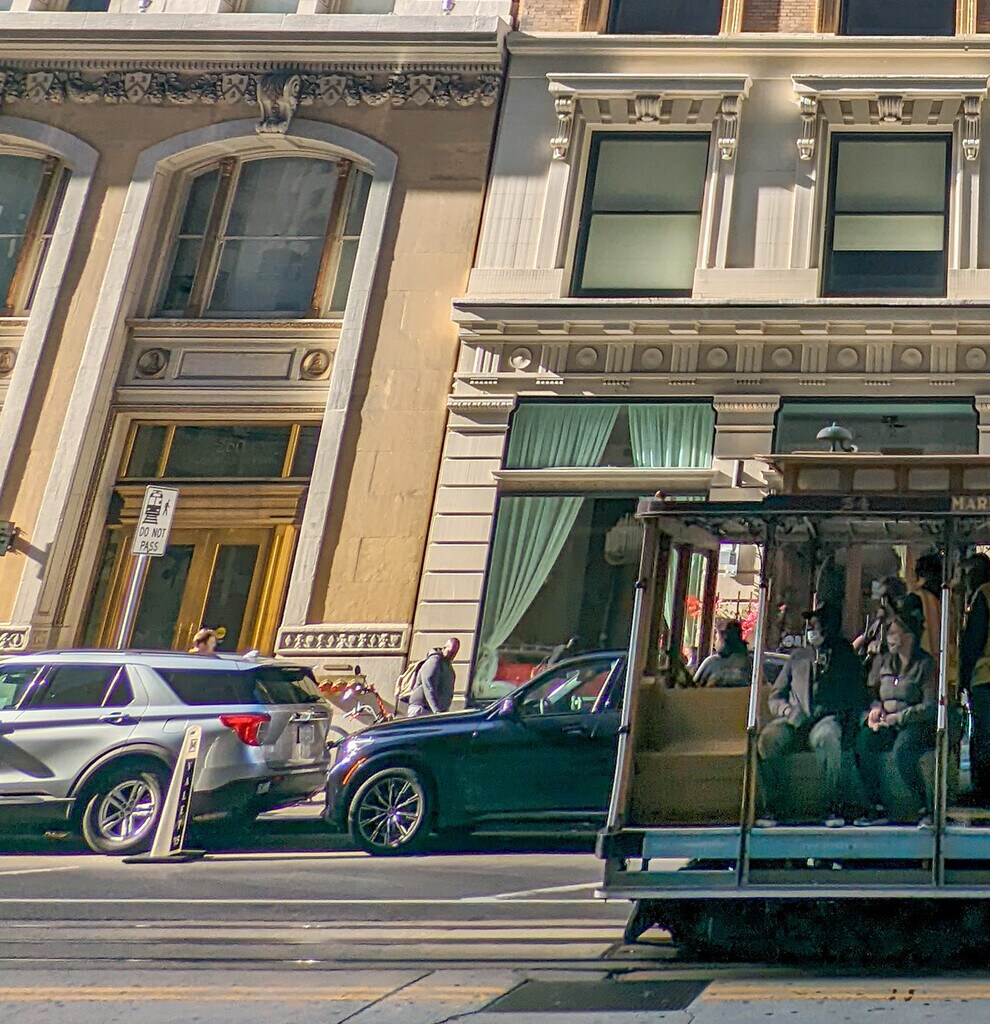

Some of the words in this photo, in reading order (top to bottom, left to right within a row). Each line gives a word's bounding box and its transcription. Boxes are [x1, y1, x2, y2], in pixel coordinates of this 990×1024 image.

[139, 526, 150, 537] DO
[151, 527, 167, 538] NOT
[140, 540, 159, 552] PASS
